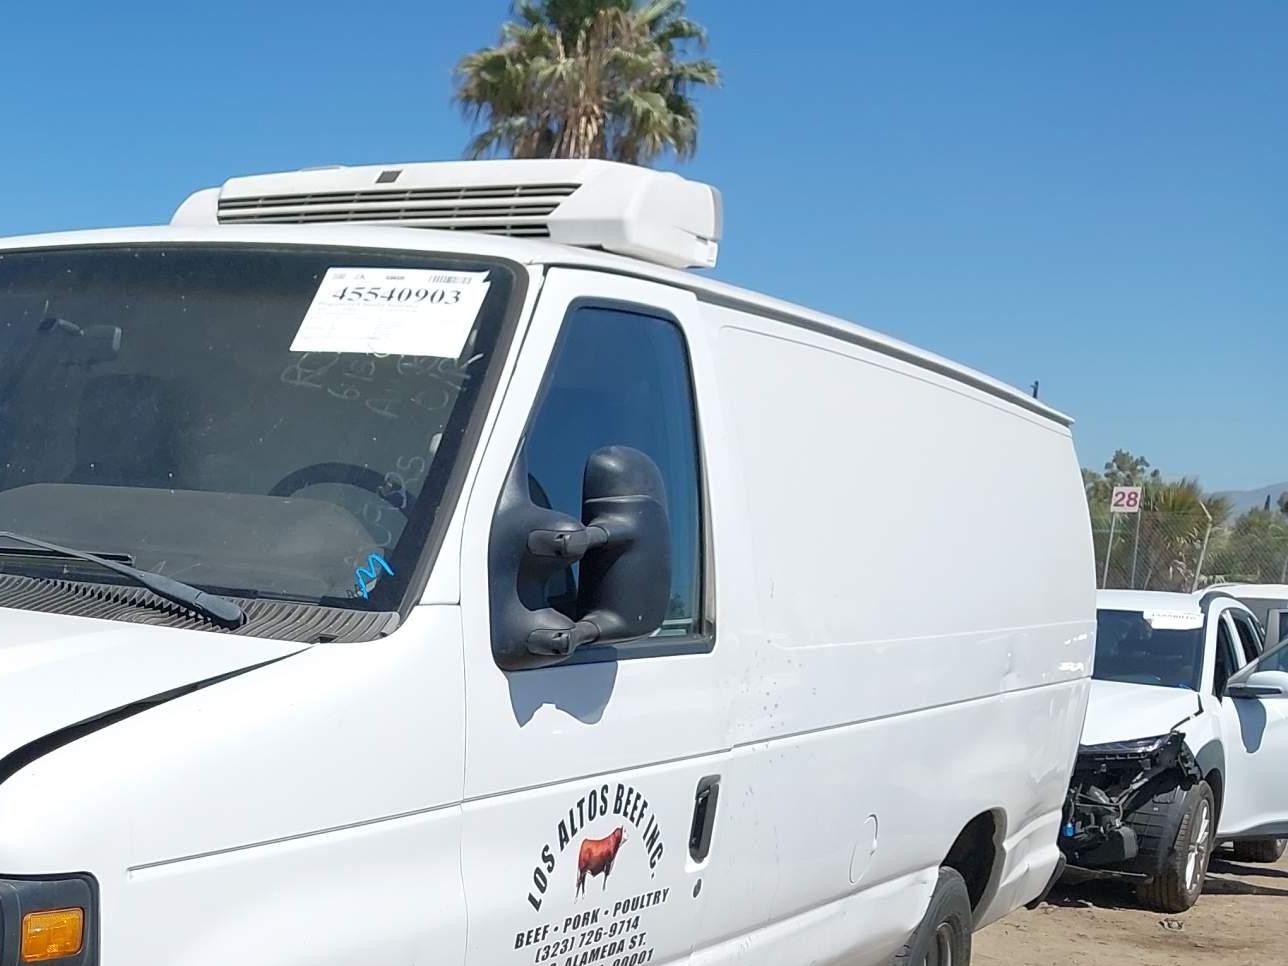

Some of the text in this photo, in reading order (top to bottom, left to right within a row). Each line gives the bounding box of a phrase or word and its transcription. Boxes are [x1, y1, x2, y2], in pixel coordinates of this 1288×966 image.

[331, 286, 462, 305] 45540903
[1112, 491, 1139, 508] 28
[527, 783, 664, 912] LOS ALTOS BEEF INC.
[514, 887, 669, 950] BEEF PORK POULTRY
[535, 916, 640, 963] (323) 726-9714
[628, 932, 647, 950] ST.
